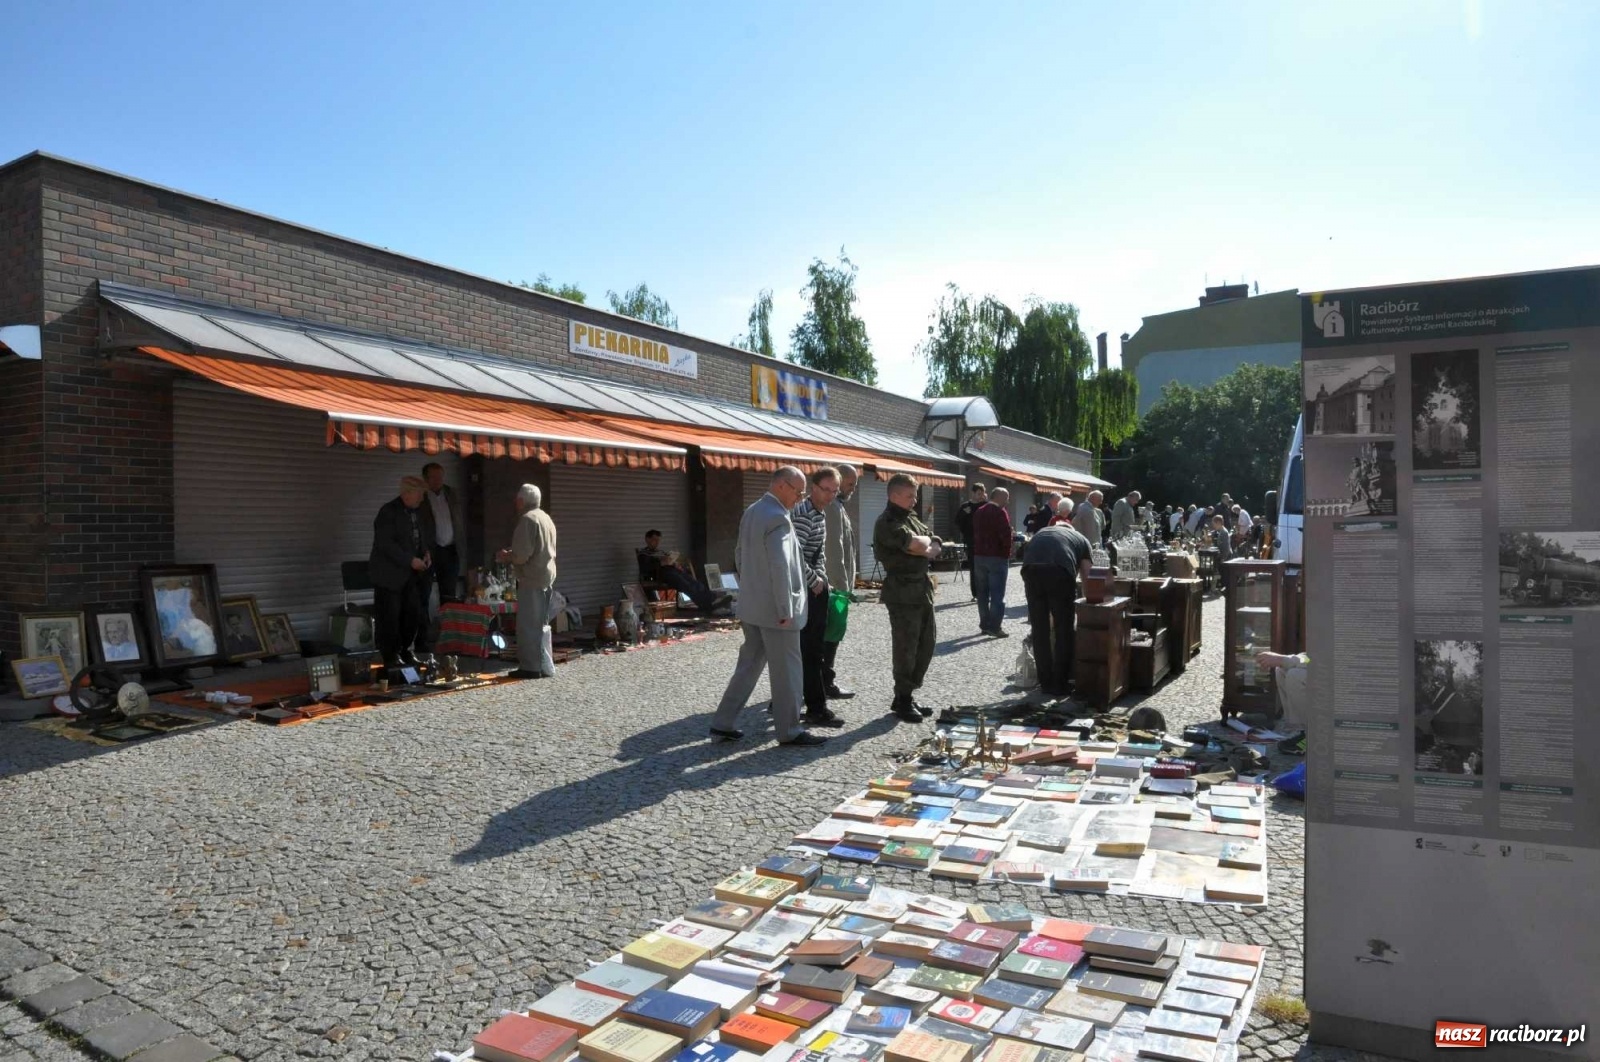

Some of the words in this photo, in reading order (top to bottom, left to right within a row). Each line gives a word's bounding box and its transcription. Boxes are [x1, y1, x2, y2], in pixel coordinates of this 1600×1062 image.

[1360, 300, 1420, 316] Racibórz
[1361, 317, 1404, 327] Powiatowy
[1405, 314, 1434, 324] System
[1435, 311, 1477, 321] Informacji
[1486, 305, 1530, 316] Atrakcjach
[1361, 325, 1410, 335] Kulturowych
[1411, 325, 1422, 333] na
[1423, 322, 1446, 332] Ziemi
[1448, 318, 1497, 329] Raciborskiej
[574, 323, 669, 364] PIEKARNIA
